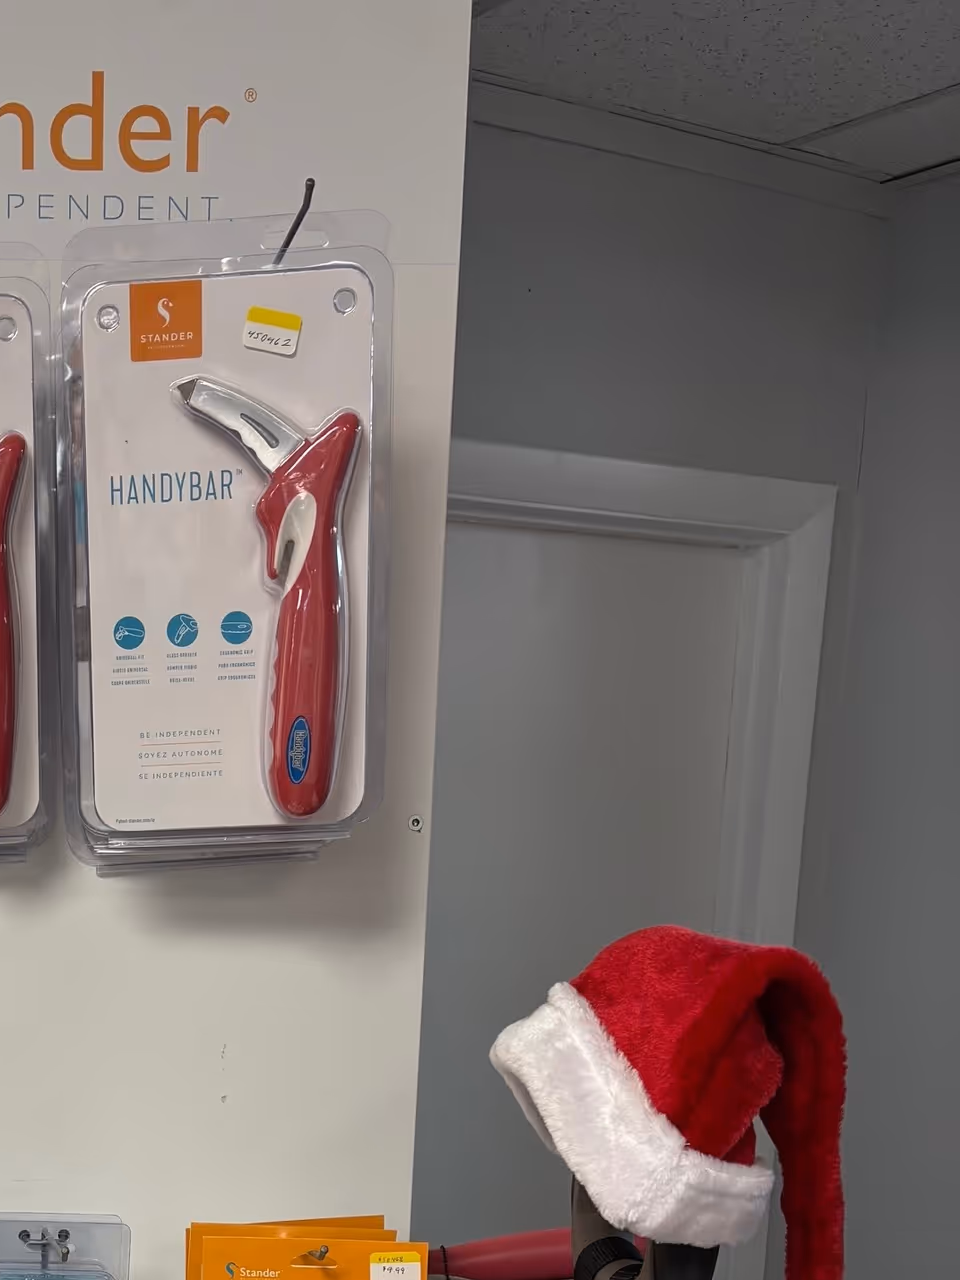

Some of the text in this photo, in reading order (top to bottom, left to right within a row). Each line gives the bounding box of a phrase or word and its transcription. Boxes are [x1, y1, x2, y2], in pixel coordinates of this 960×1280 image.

[140, 332, 194, 344] STANDER
[248, 330, 292, 347] 450462
[155, 729, 221, 738] INDEPENDENT
[172, 749, 223, 758] AUTONOME
[152, 770, 223, 779] INDEPENDIENTE
[240, 1268, 281, 1278] Stander
